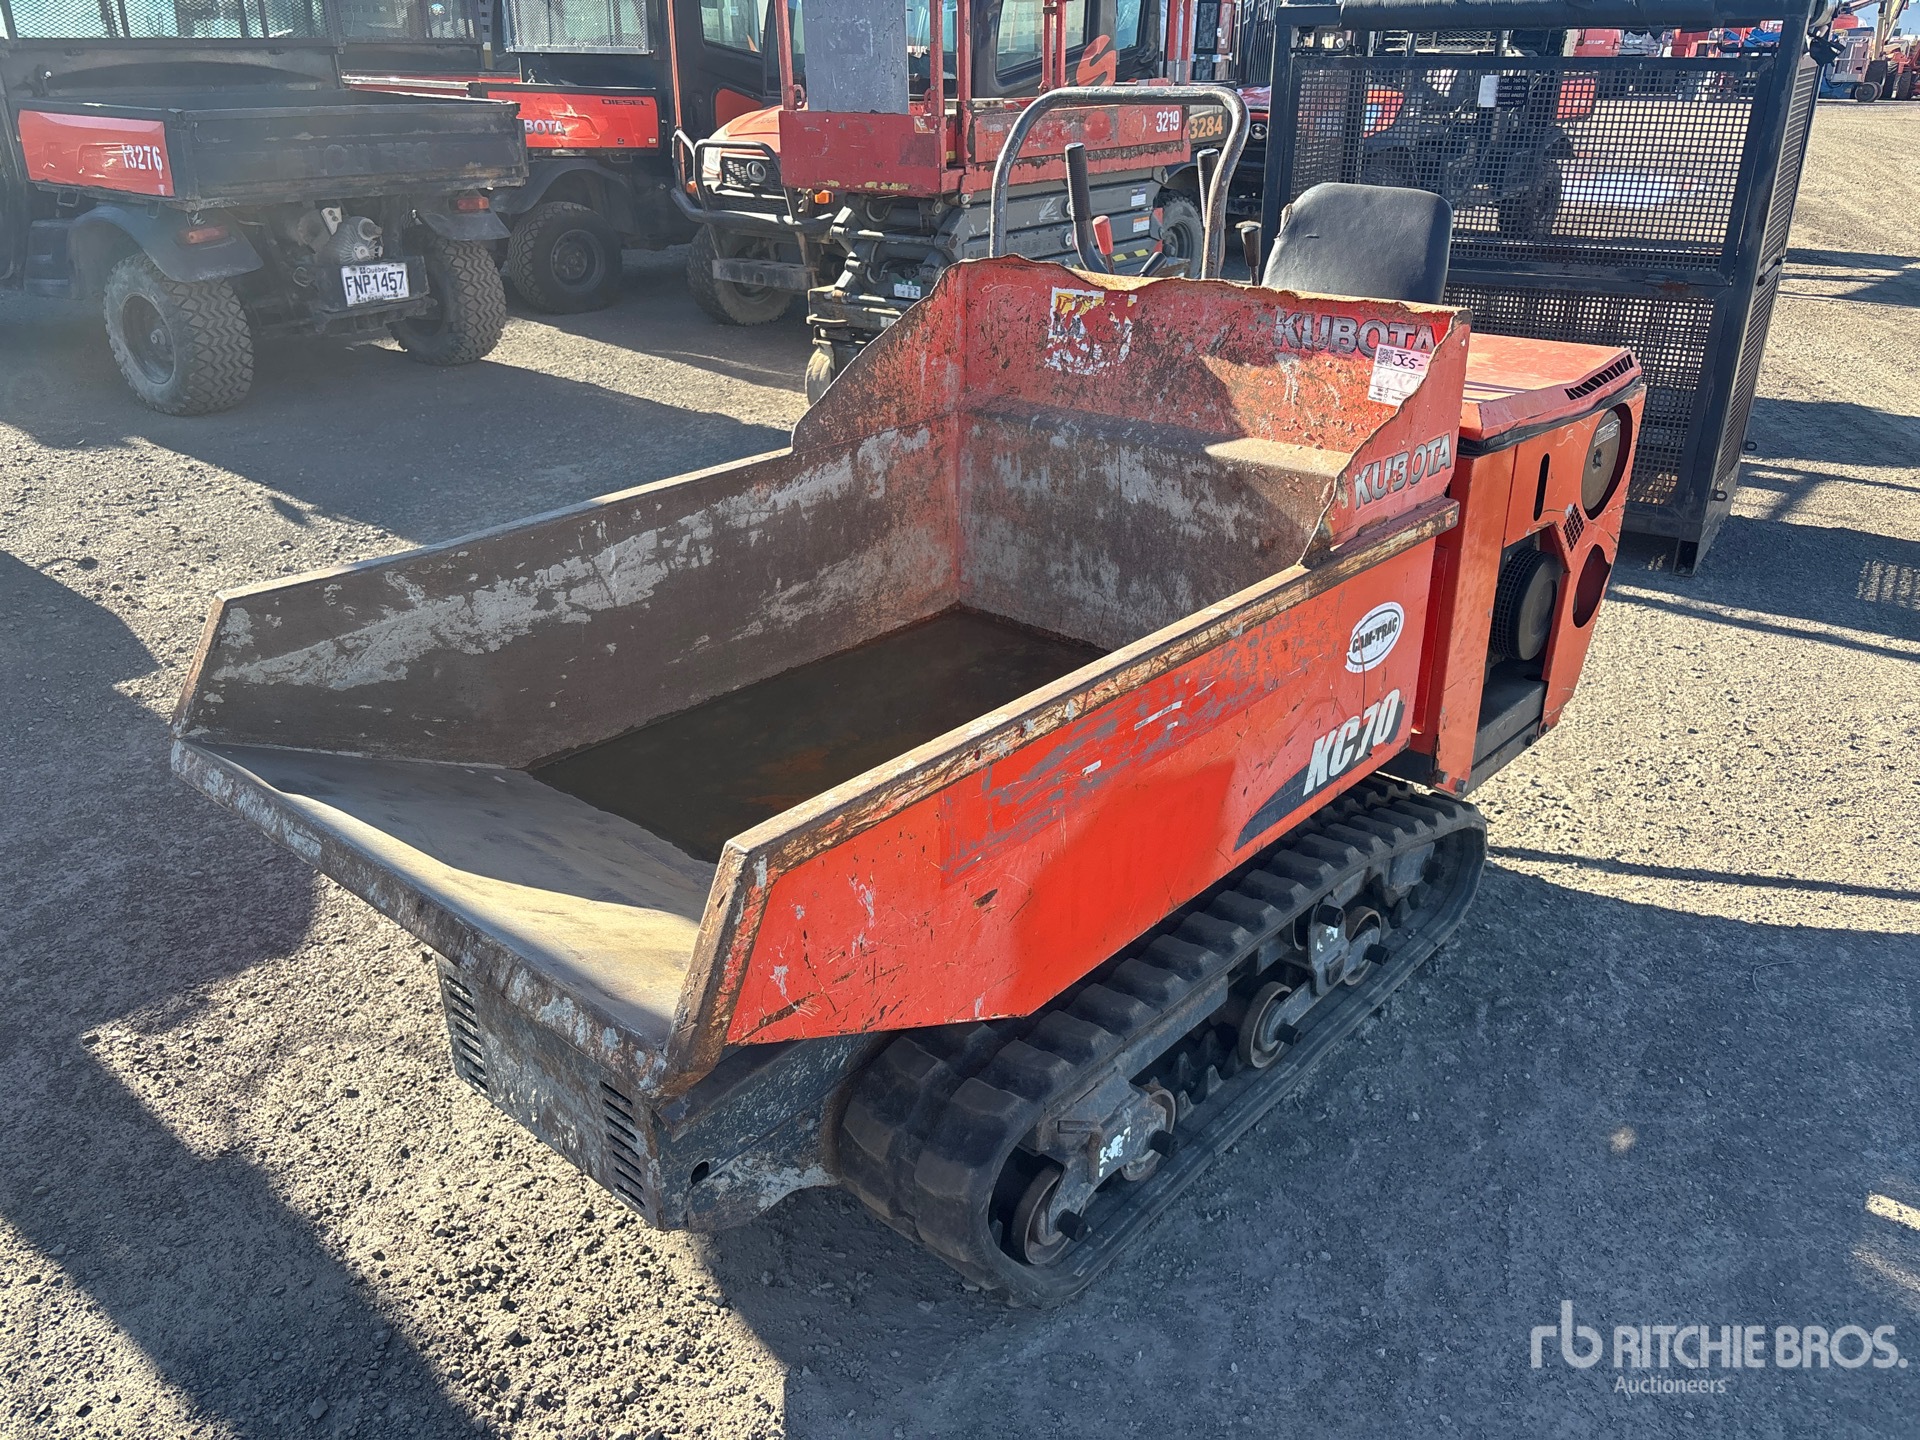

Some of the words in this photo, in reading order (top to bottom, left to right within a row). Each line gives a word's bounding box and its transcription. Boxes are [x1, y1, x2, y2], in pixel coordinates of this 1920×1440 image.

[601, 98, 650, 107] DIESEL
[1155, 110, 1180, 133] 3219
[1189, 114, 1224, 140] 3284
[366, 265, 389, 275] Québec
[1272, 307, 1437, 360] KUBOTA
[1354, 432, 1452, 511] KUBOTA
[1351, 616, 1398, 654] CAM-TRAC
[1303, 688, 1401, 797] KC70
